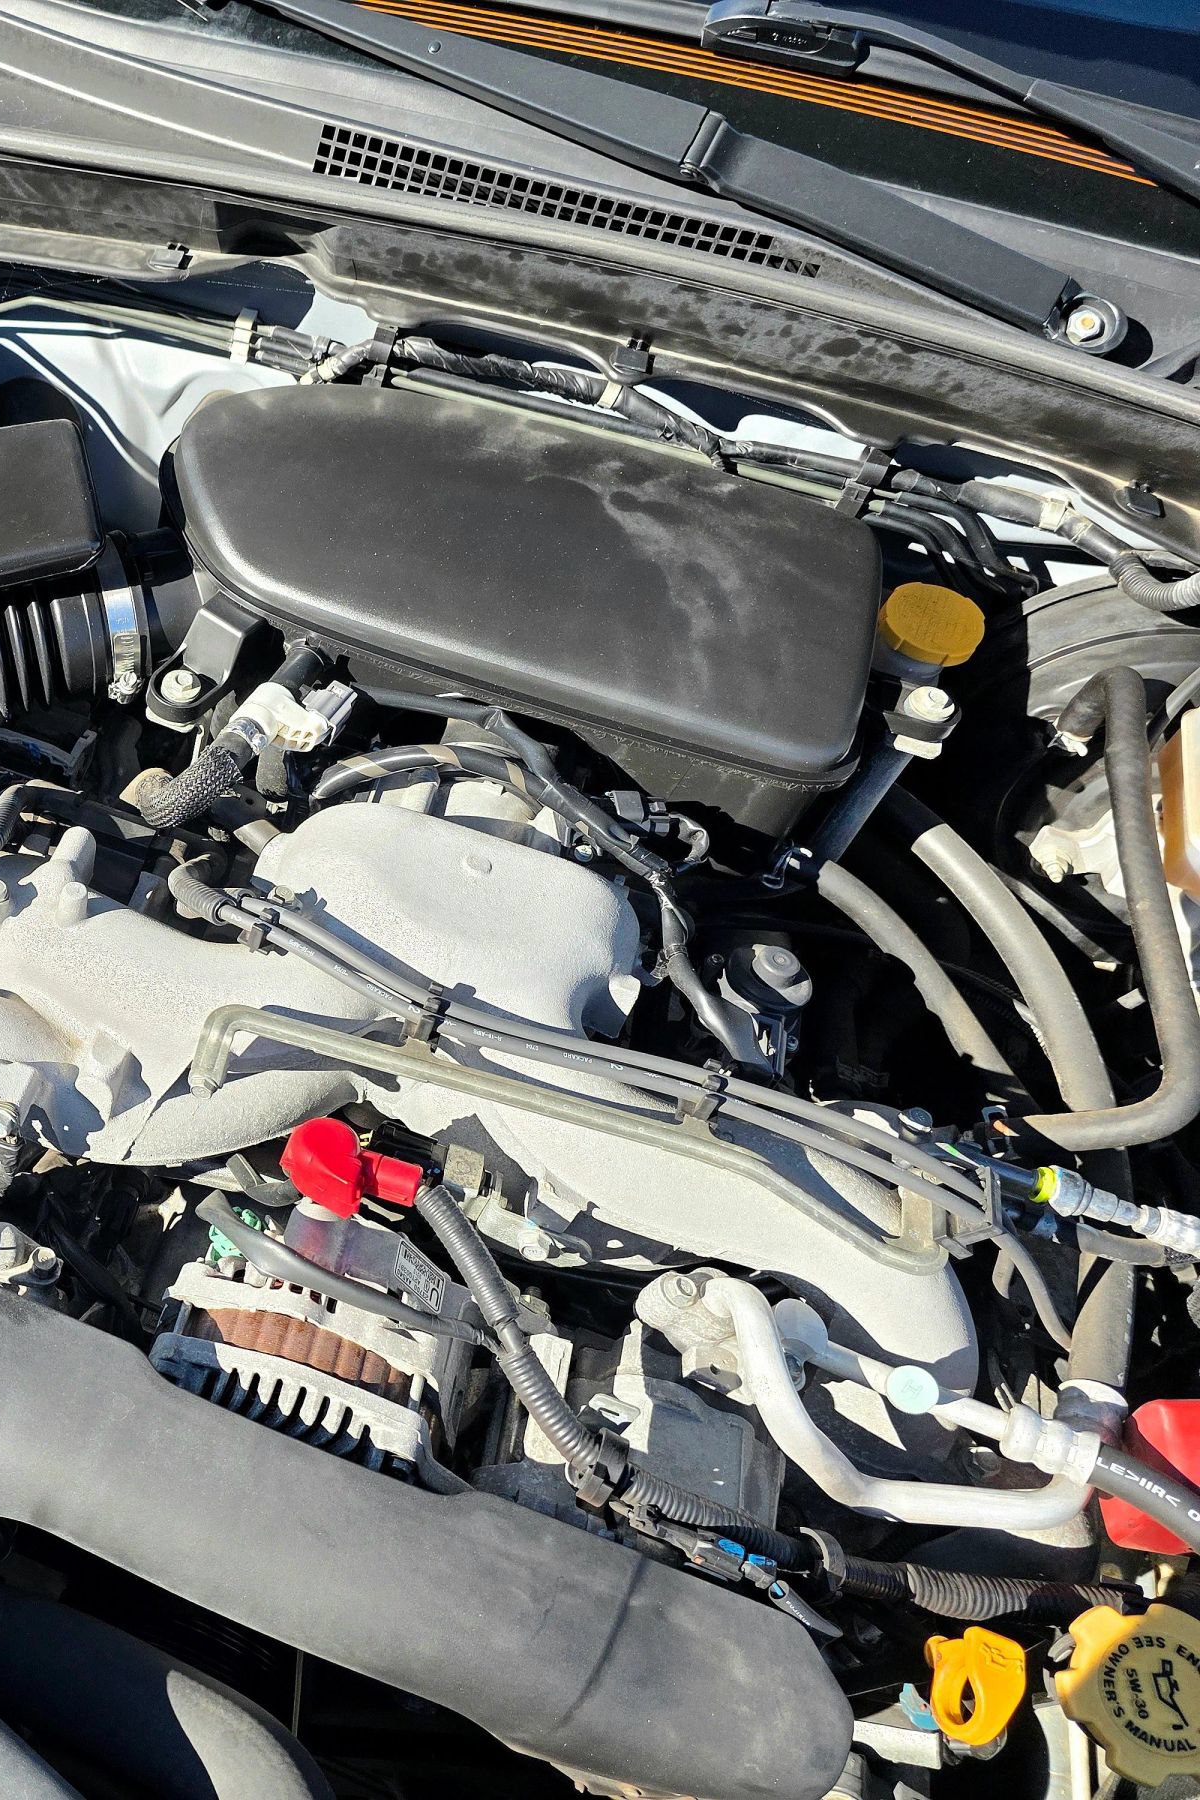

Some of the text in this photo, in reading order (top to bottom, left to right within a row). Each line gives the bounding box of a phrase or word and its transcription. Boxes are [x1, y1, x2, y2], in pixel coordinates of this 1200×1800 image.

[366, 983, 394, 1001] PACKARD
[408, 1004, 420, 1014] 2
[562, 1052, 593, 1064] PACKARD
[610, 1063, 624, 1071] 2
[1175, 1644, 1200, 1675] EN
[1103, 1635, 1197, 1752] SEE OWNER'S MANUAL
[1125, 1668, 1149, 1720] 5W-30
